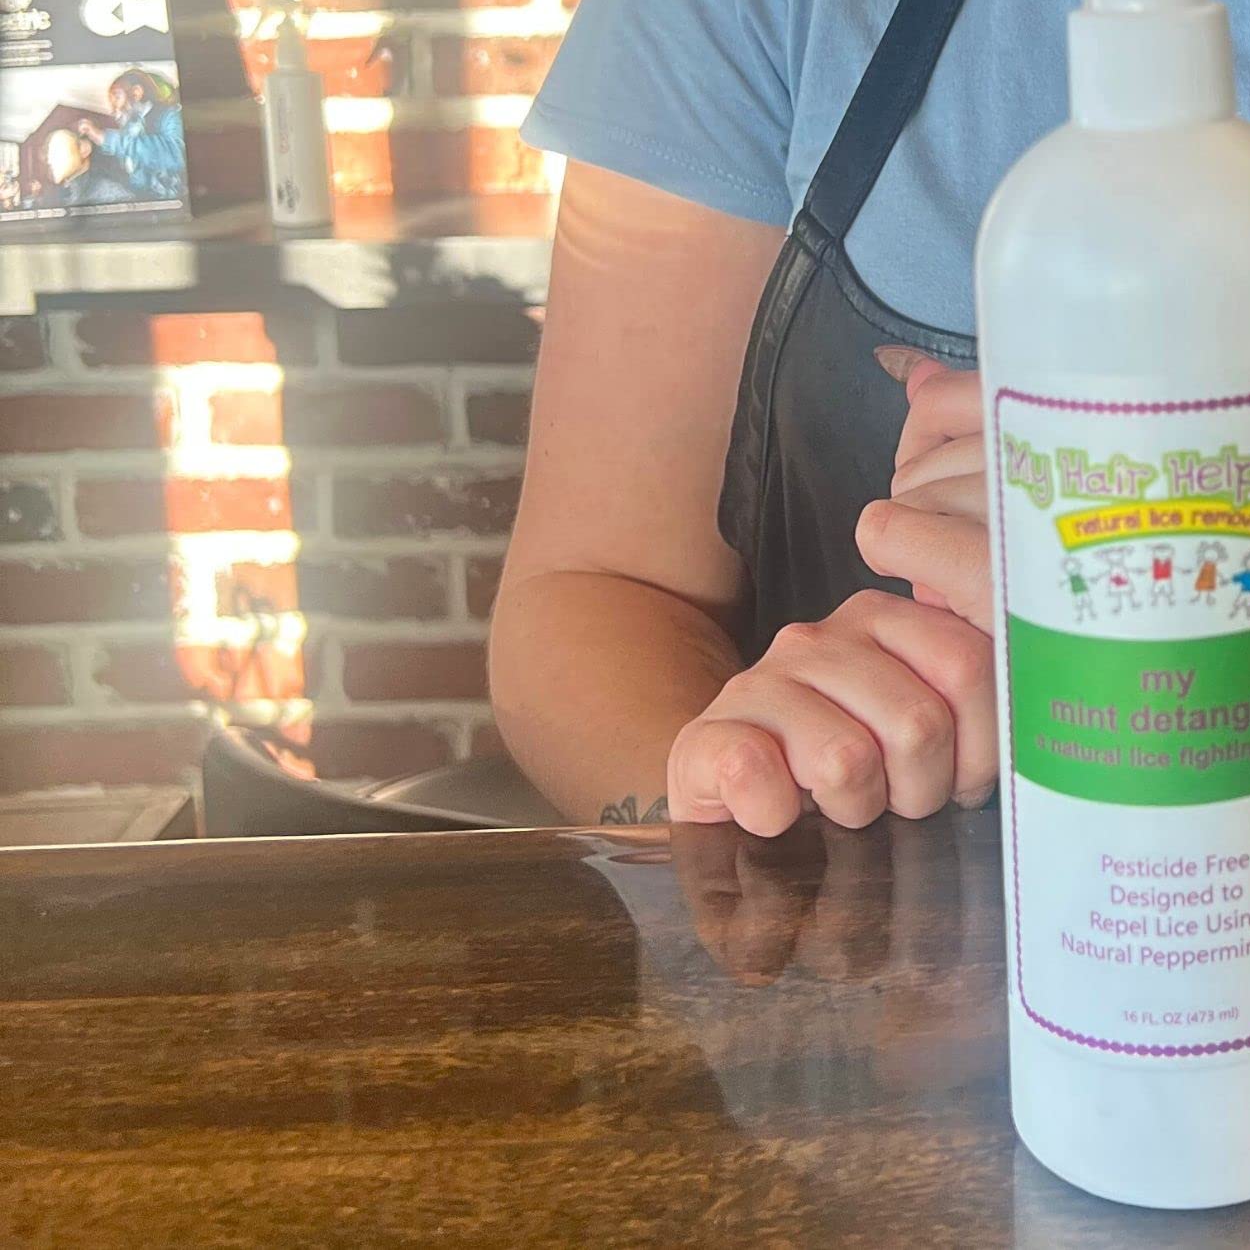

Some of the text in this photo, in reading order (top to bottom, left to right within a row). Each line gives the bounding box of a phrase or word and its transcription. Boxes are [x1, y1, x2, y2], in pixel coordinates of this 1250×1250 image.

[1004, 434, 1053, 509] My
[1058, 450, 1154, 497] Hair
[1075, 508, 1141, 536] natural
[1150, 507, 1181, 526] lice
[1141, 668, 1196, 697] my
[1051, 699, 1117, 732] mint
[1051, 734, 1121, 767] natural
[1130, 747, 1171, 767] lice
[1101, 853, 1250, 878] Pesticide Free
[1110, 883, 1243, 913] Designed to
[1090, 910, 1147, 939] Repel
[1155, 916, 1198, 937] Lice
[1061, 931, 1131, 964] Natural
[1123, 1011, 1138, 1022] 16
[1163, 1011, 1182, 1025] OZ
[1186, 1009, 1215, 1025] (473
[1219, 1006, 1239, 1022] ml)
